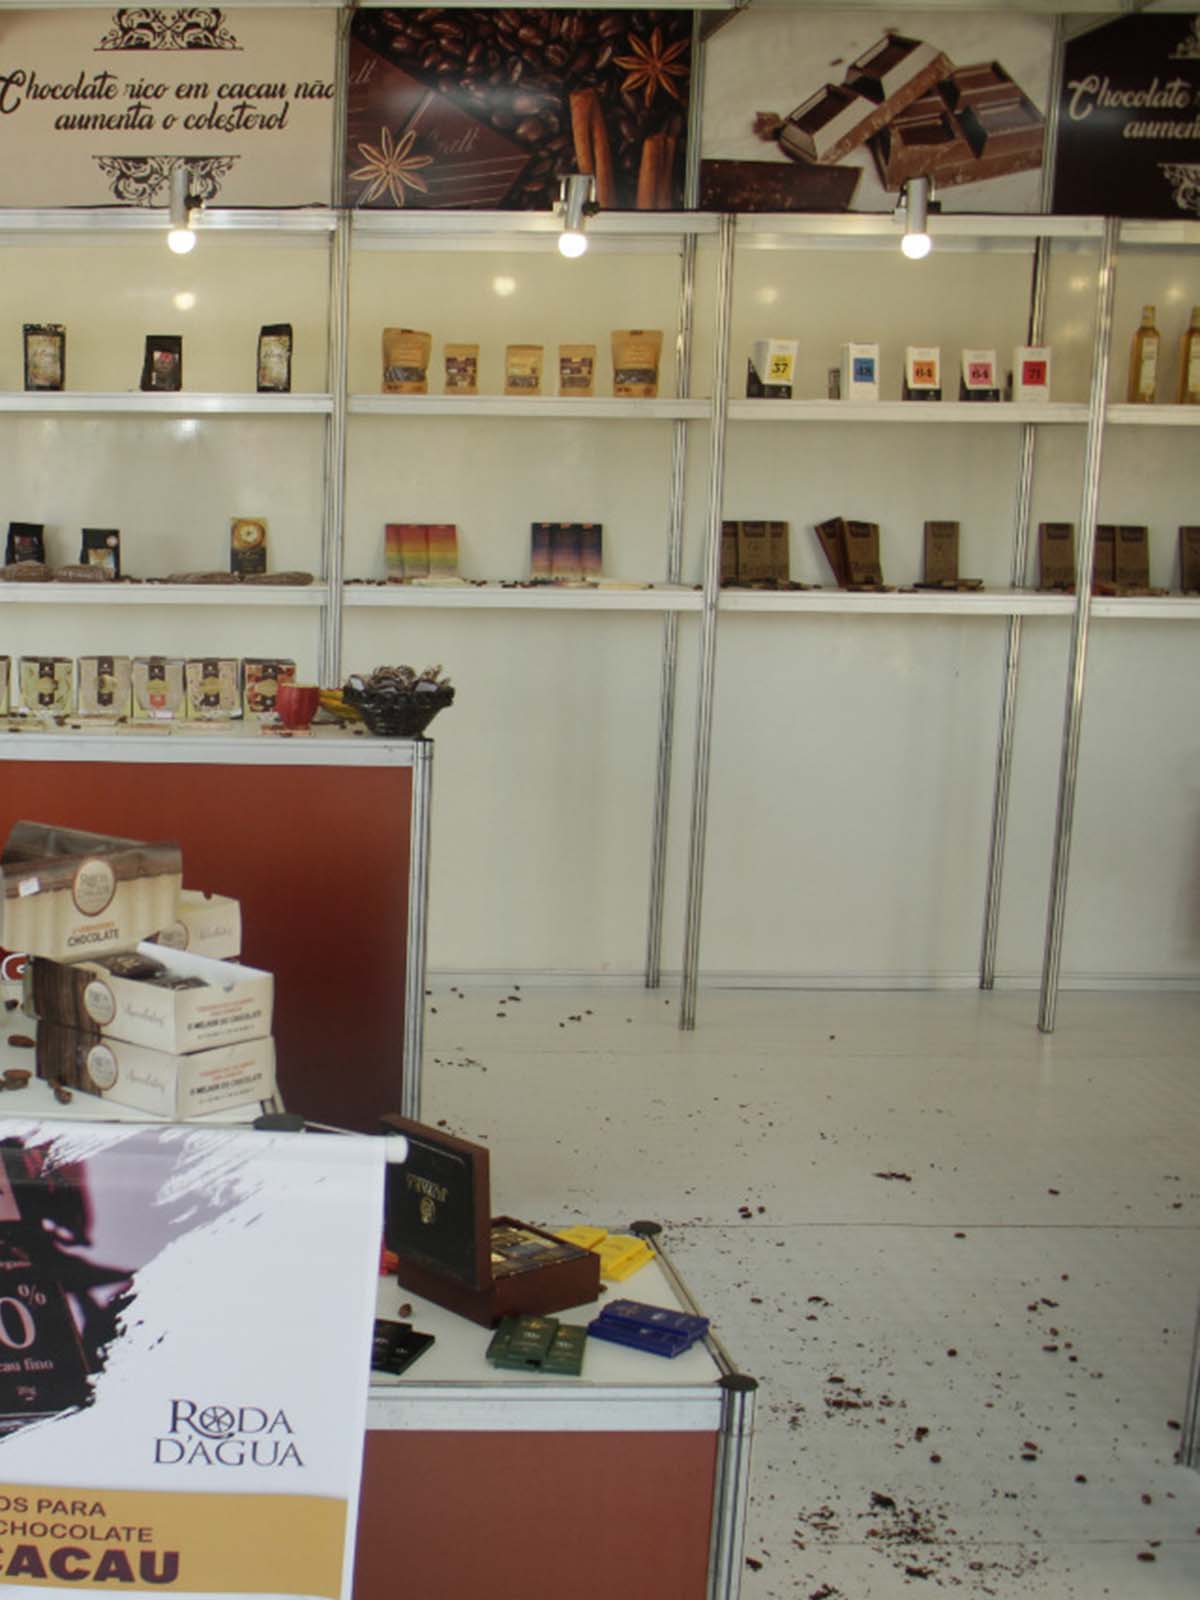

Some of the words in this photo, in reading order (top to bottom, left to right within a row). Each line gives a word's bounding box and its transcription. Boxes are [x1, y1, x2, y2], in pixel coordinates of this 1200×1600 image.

[125, 78, 169, 99] rico
[175, 82, 208, 99] em
[217, 81, 288, 99] cacau
[1067, 75, 1193, 120] Chocolate
[54, 101, 155, 130] aumenta
[162, 112, 179, 130] o
[183, 101, 289, 133] colesterol
[67, 928, 120, 947] CHOCOLATE
[24, 1357, 54, 1371] fino
[167, 1398, 295, 1439] RODA
[36, 1498, 107, 1518] PARA
